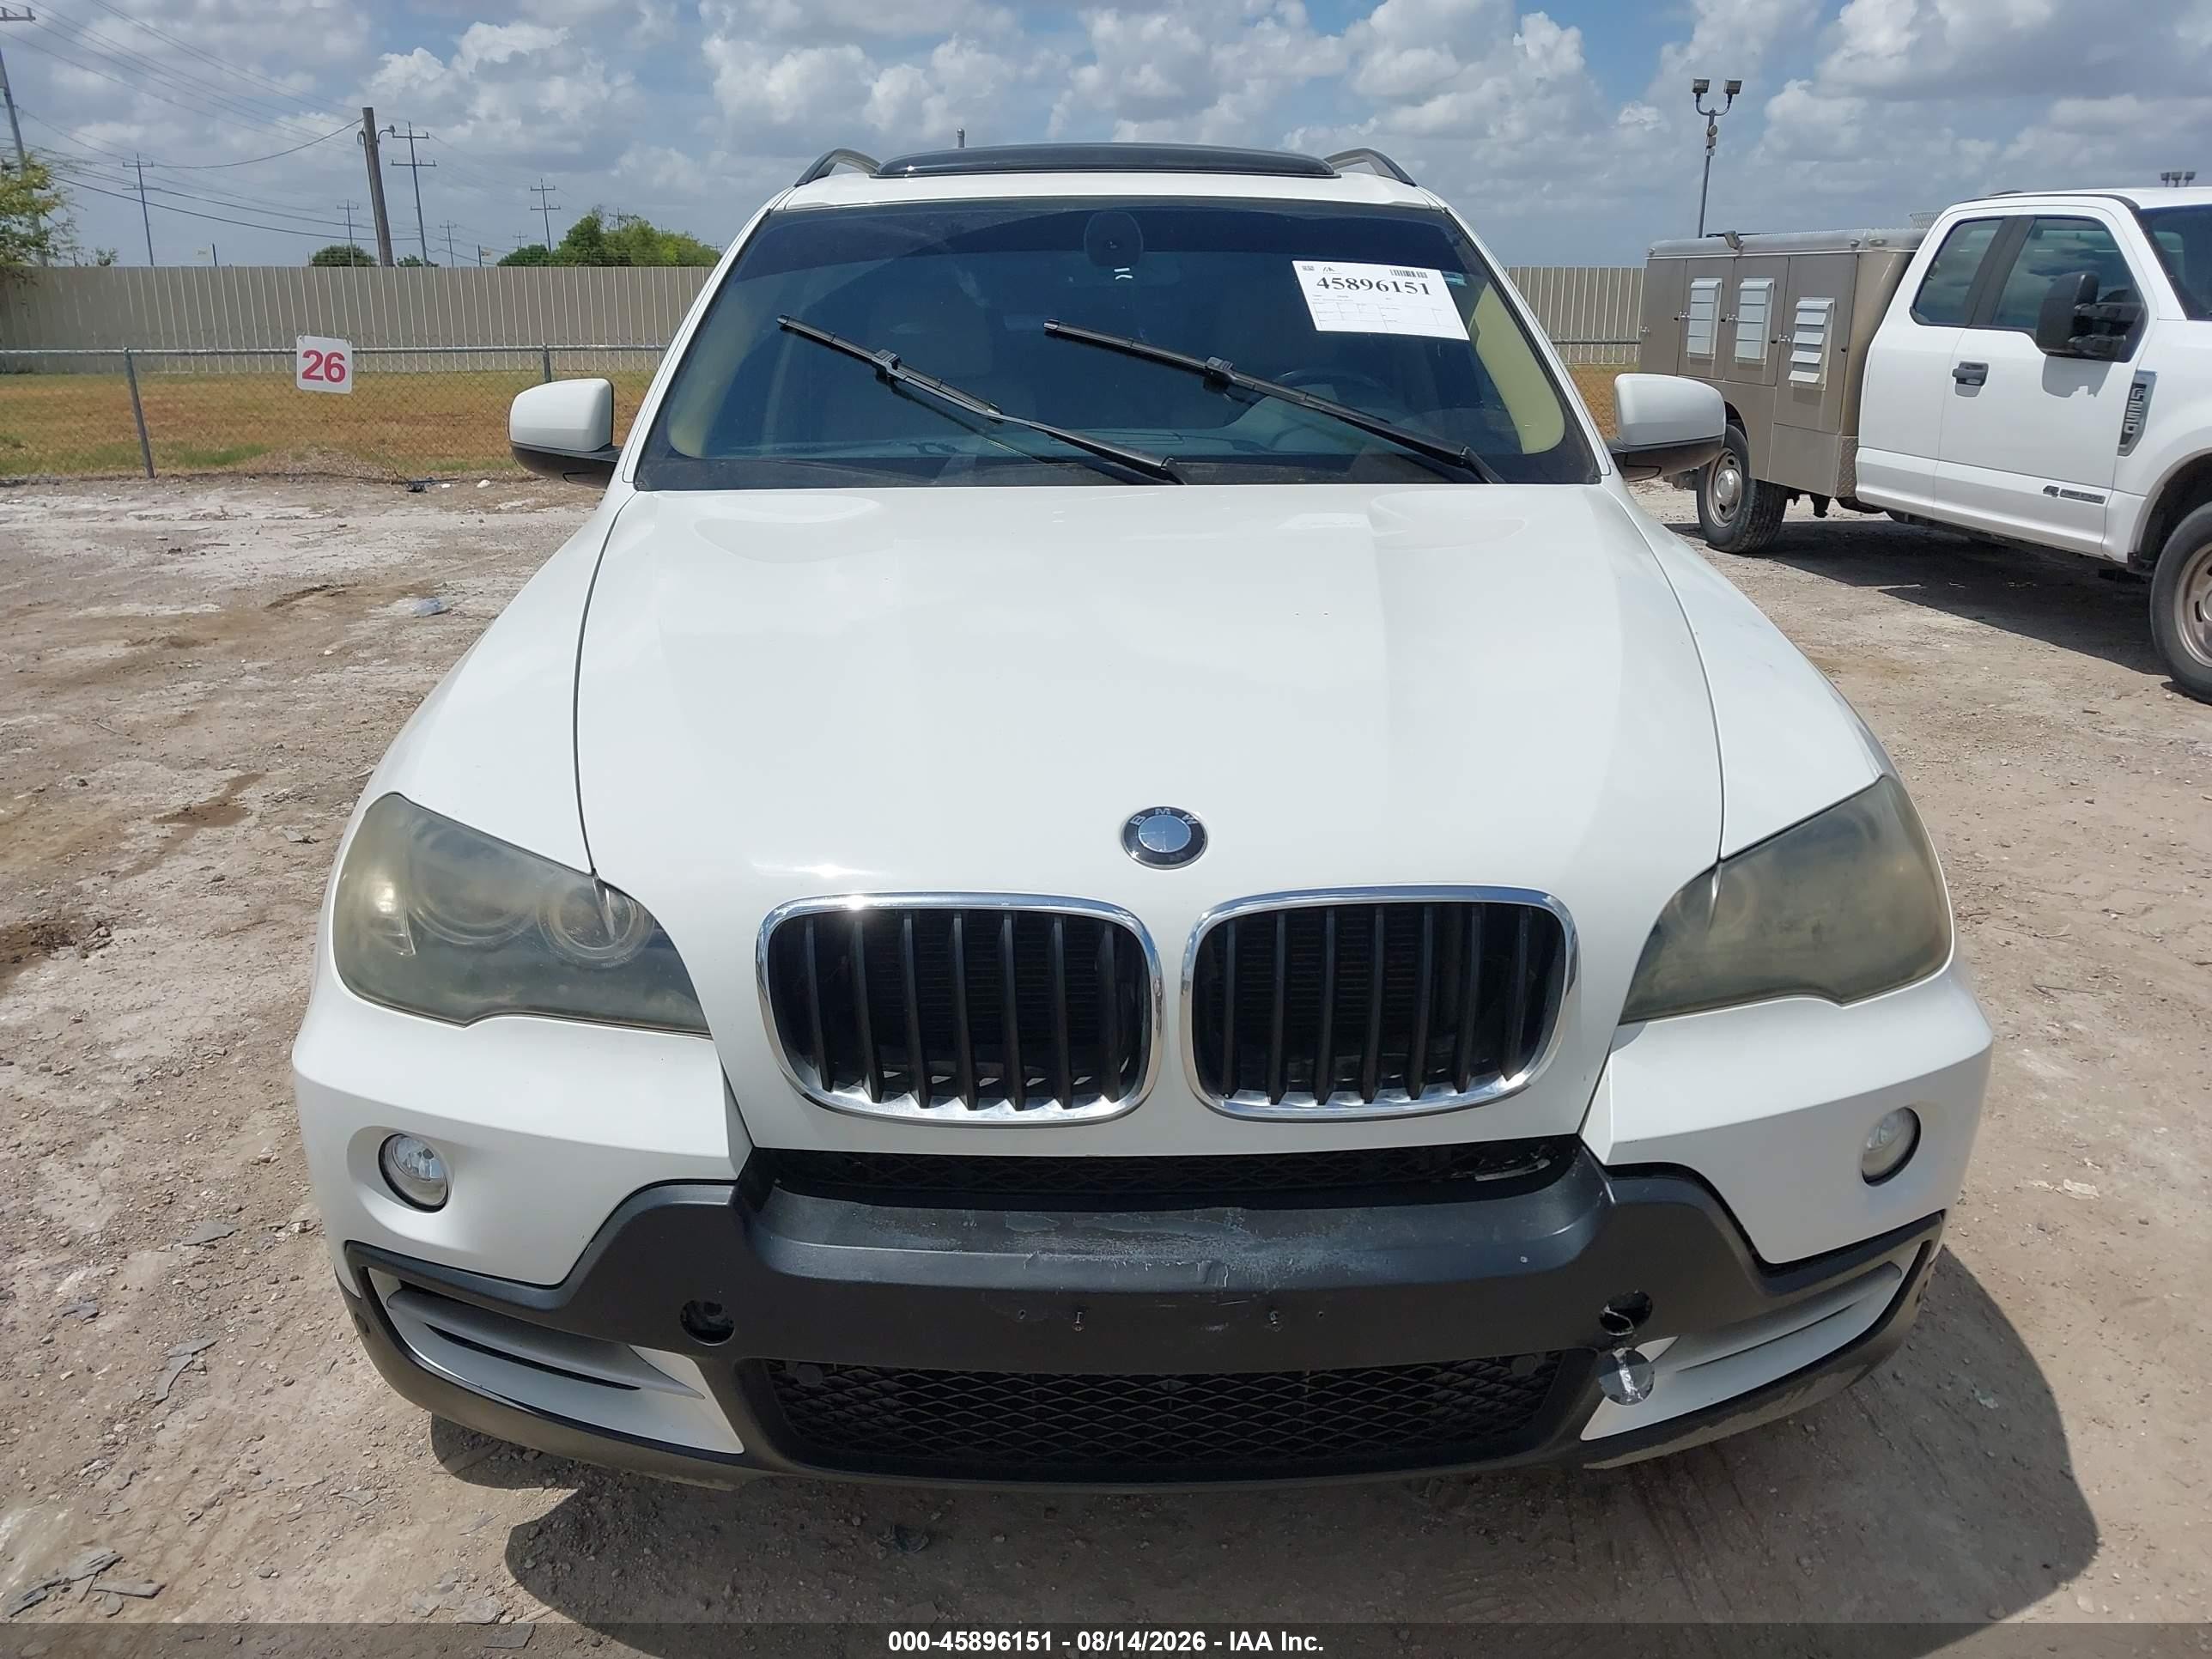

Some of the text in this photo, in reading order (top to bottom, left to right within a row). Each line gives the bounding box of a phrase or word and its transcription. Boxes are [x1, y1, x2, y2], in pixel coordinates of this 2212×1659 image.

[1316, 276, 1432, 296] 45896151
[301, 349, 346, 384] 26
[1129, 808, 1198, 826] BMW
